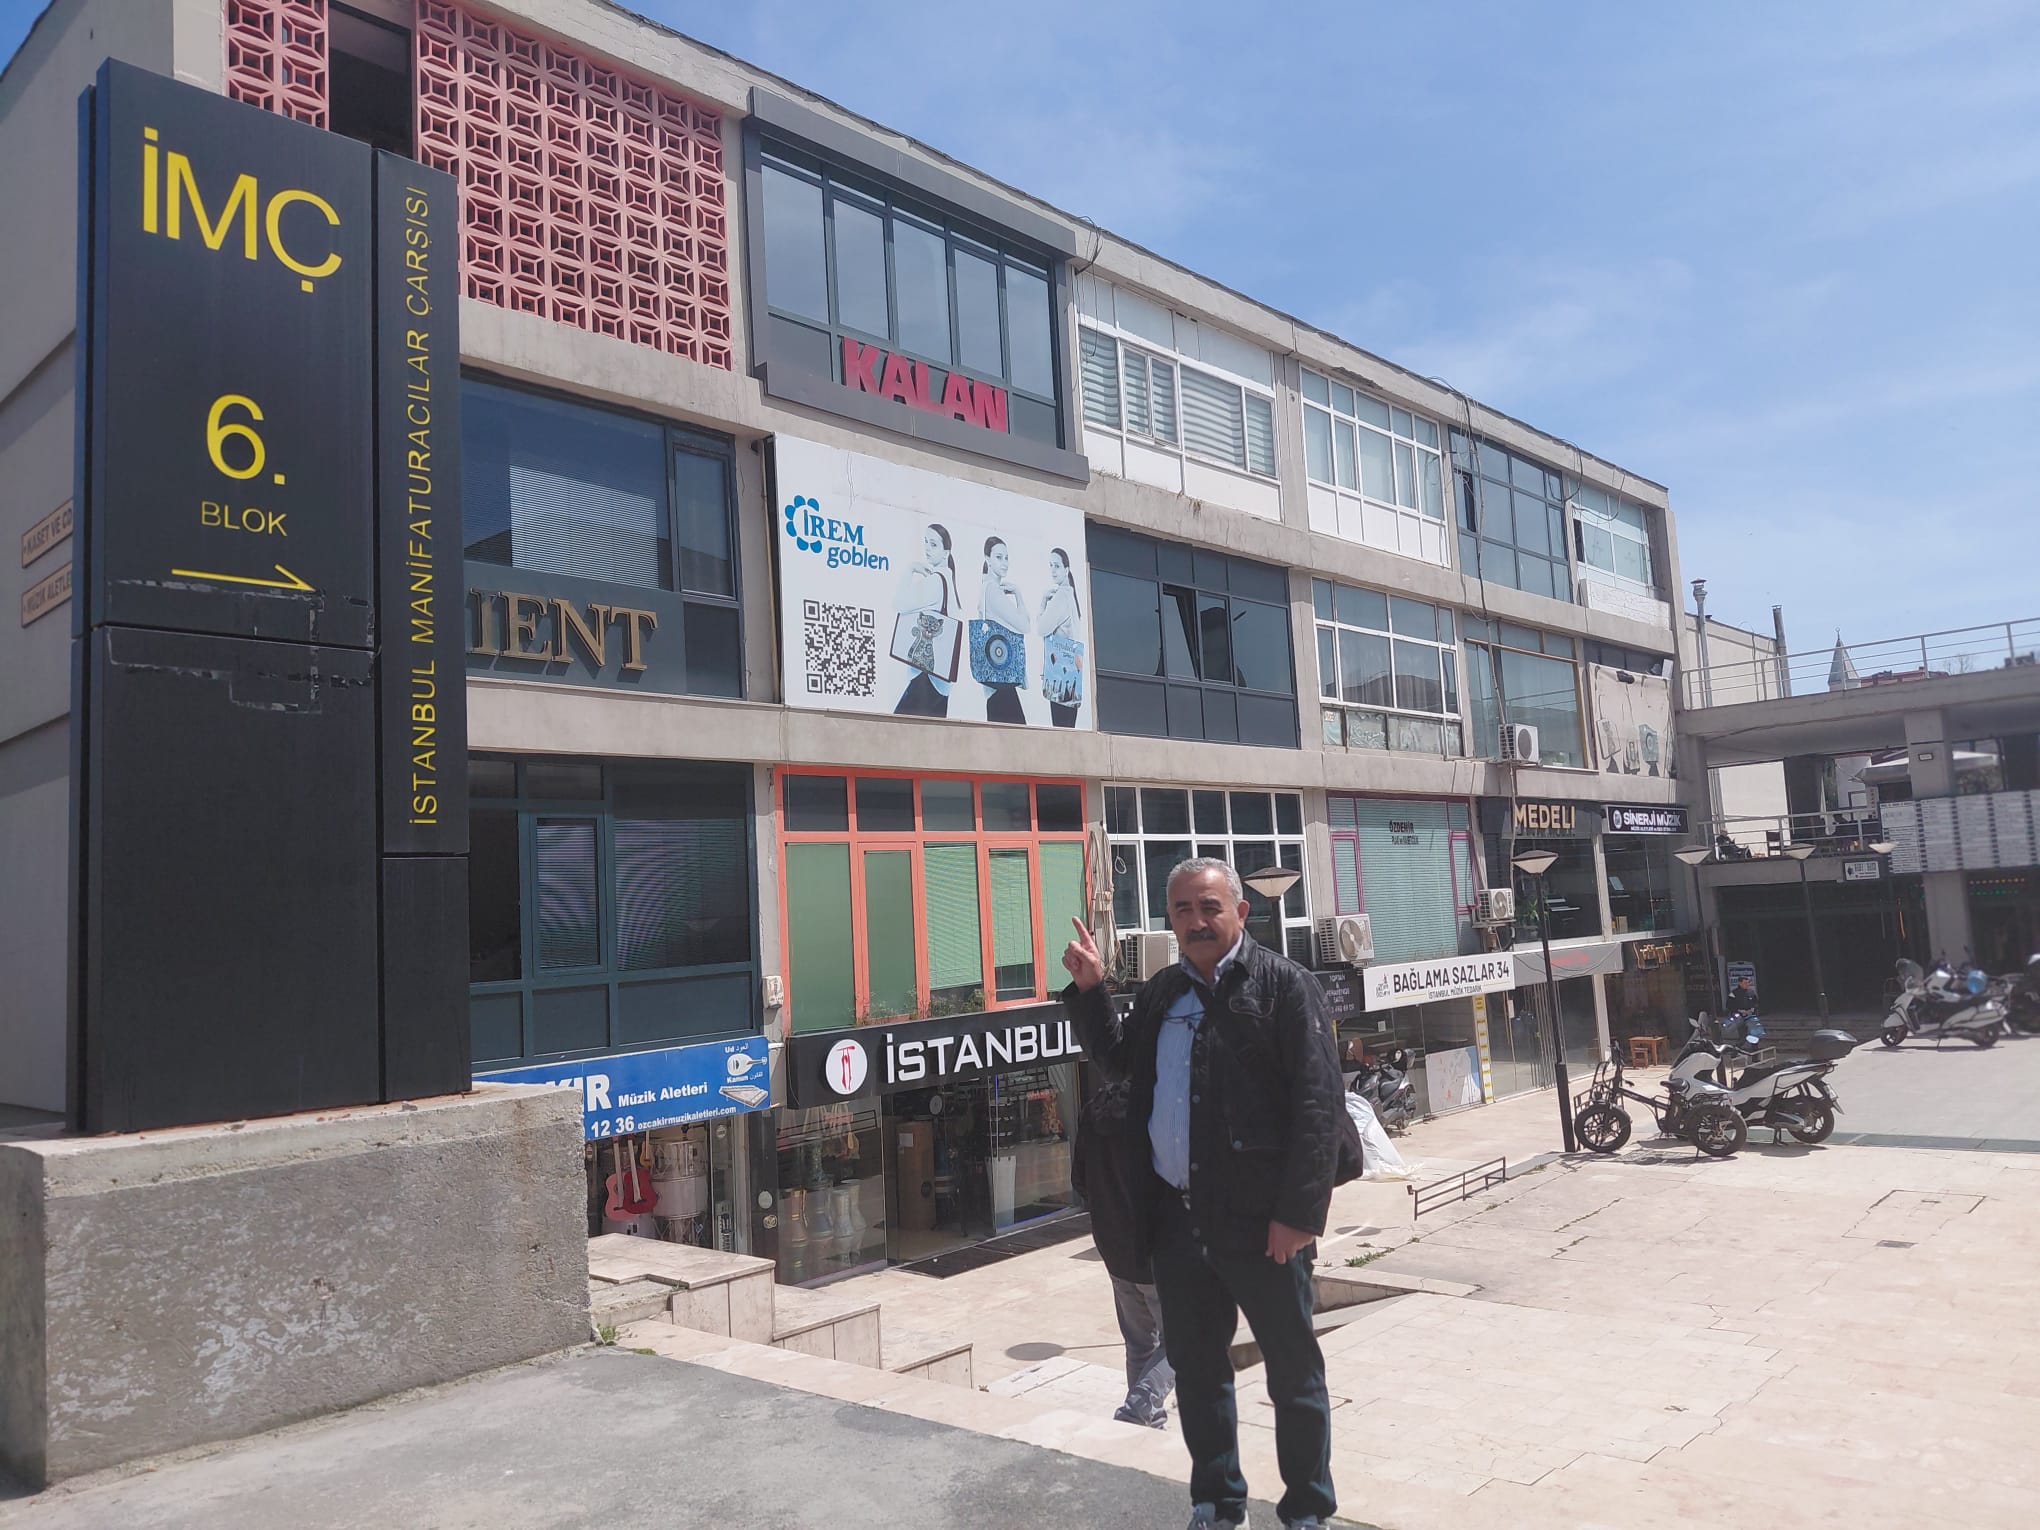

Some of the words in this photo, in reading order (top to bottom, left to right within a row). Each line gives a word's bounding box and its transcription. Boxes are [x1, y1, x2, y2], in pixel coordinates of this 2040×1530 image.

[143, 126, 343, 293] İMÇ
[405, 186, 433, 316] ÇARŞISI
[843, 335, 1008, 433] KALAN
[206, 393, 286, 485] 6.
[406, 329, 435, 644] MANİFATURACILAR
[201, 500, 288, 537] BLOK
[826, 545, 890, 572] goblen
[409, 659, 438, 825] İSTANBUL
[1514, 803, 1576, 830] MEDELI
[1623, 808, 1656, 826] SİNERJİ
[1656, 810, 1682, 827] MÜZİK
[1393, 966, 1451, 994] BAĞLAMA
[1452, 962, 1496, 985] SAZLAR
[1497, 960, 1510, 979] 34
[886, 1020, 1083, 1085] İSTANBUL
[618, 1090, 657, 1108] Müzik
[660, 1081, 708, 1101] Aletleri
[591, 1119, 611, 1138] 12
[615, 1115, 635, 1134] 36
